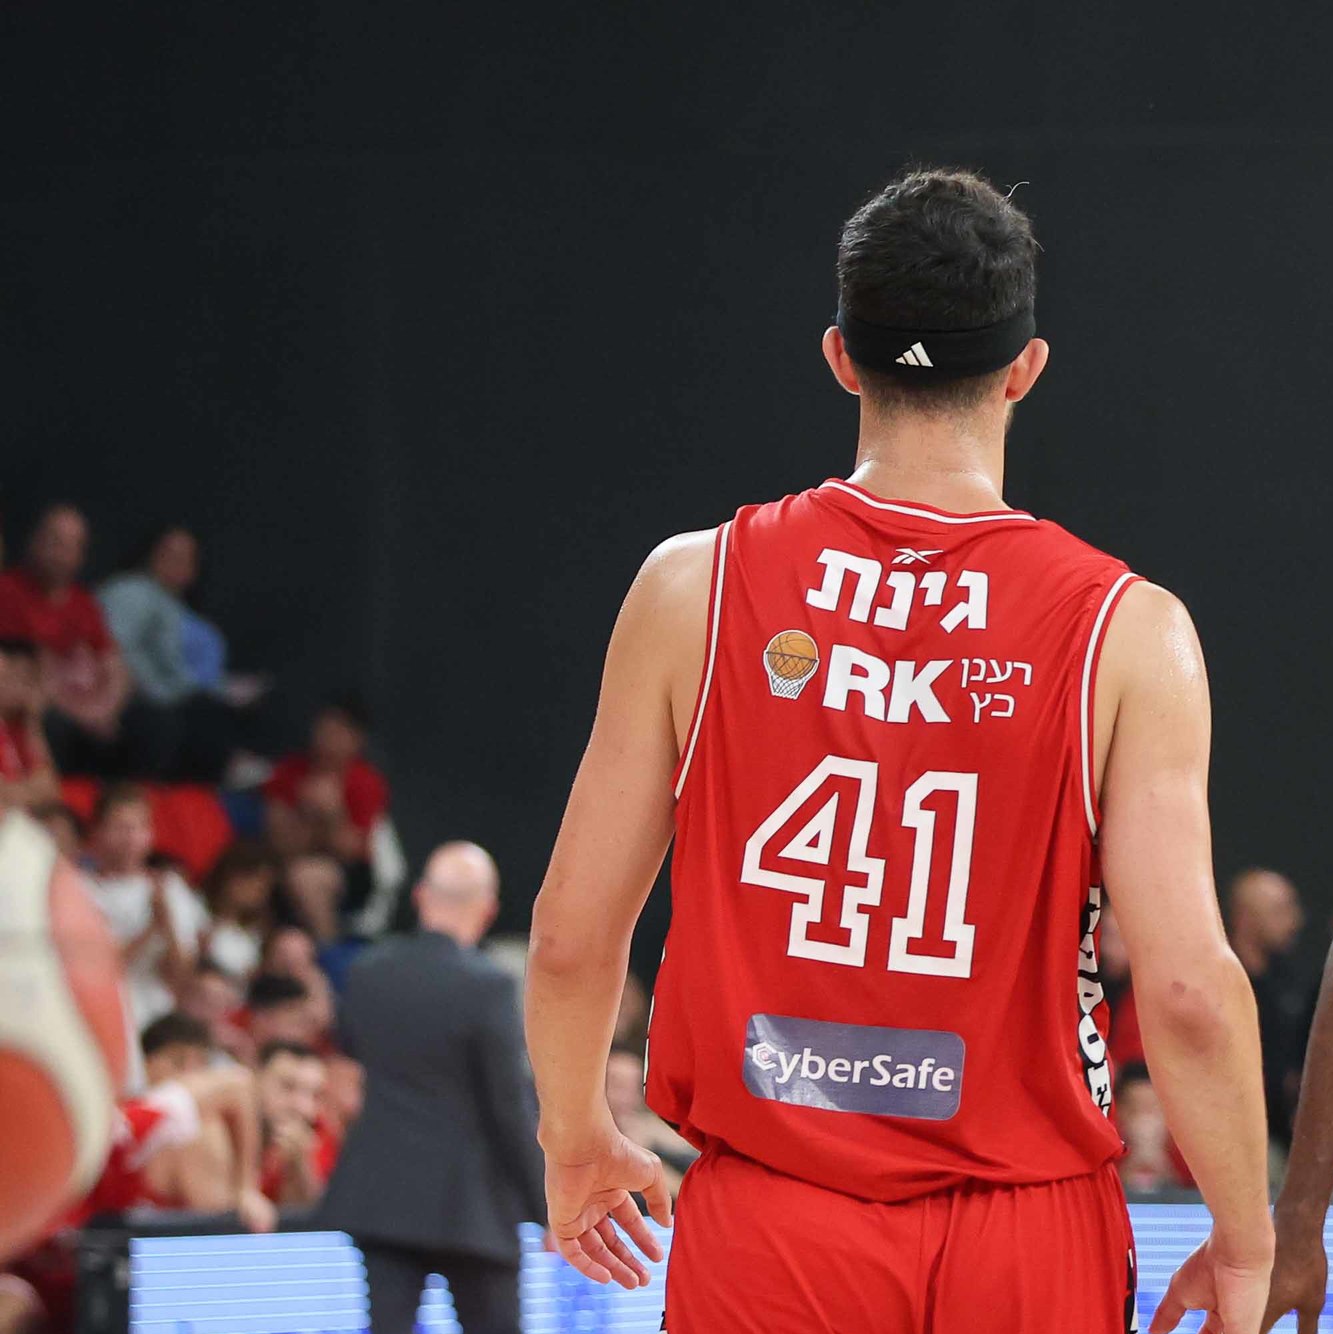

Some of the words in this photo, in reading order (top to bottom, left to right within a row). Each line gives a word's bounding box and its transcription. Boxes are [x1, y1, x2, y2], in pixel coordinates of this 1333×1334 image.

[806, 548, 989, 633] גינת
[822, 644, 953, 723] RK
[961, 657, 1033, 688] רענן
[970, 692, 1016, 724] כץ
[740, 754, 979, 979] 41
[752, 1041, 954, 1092] CyberSafe
